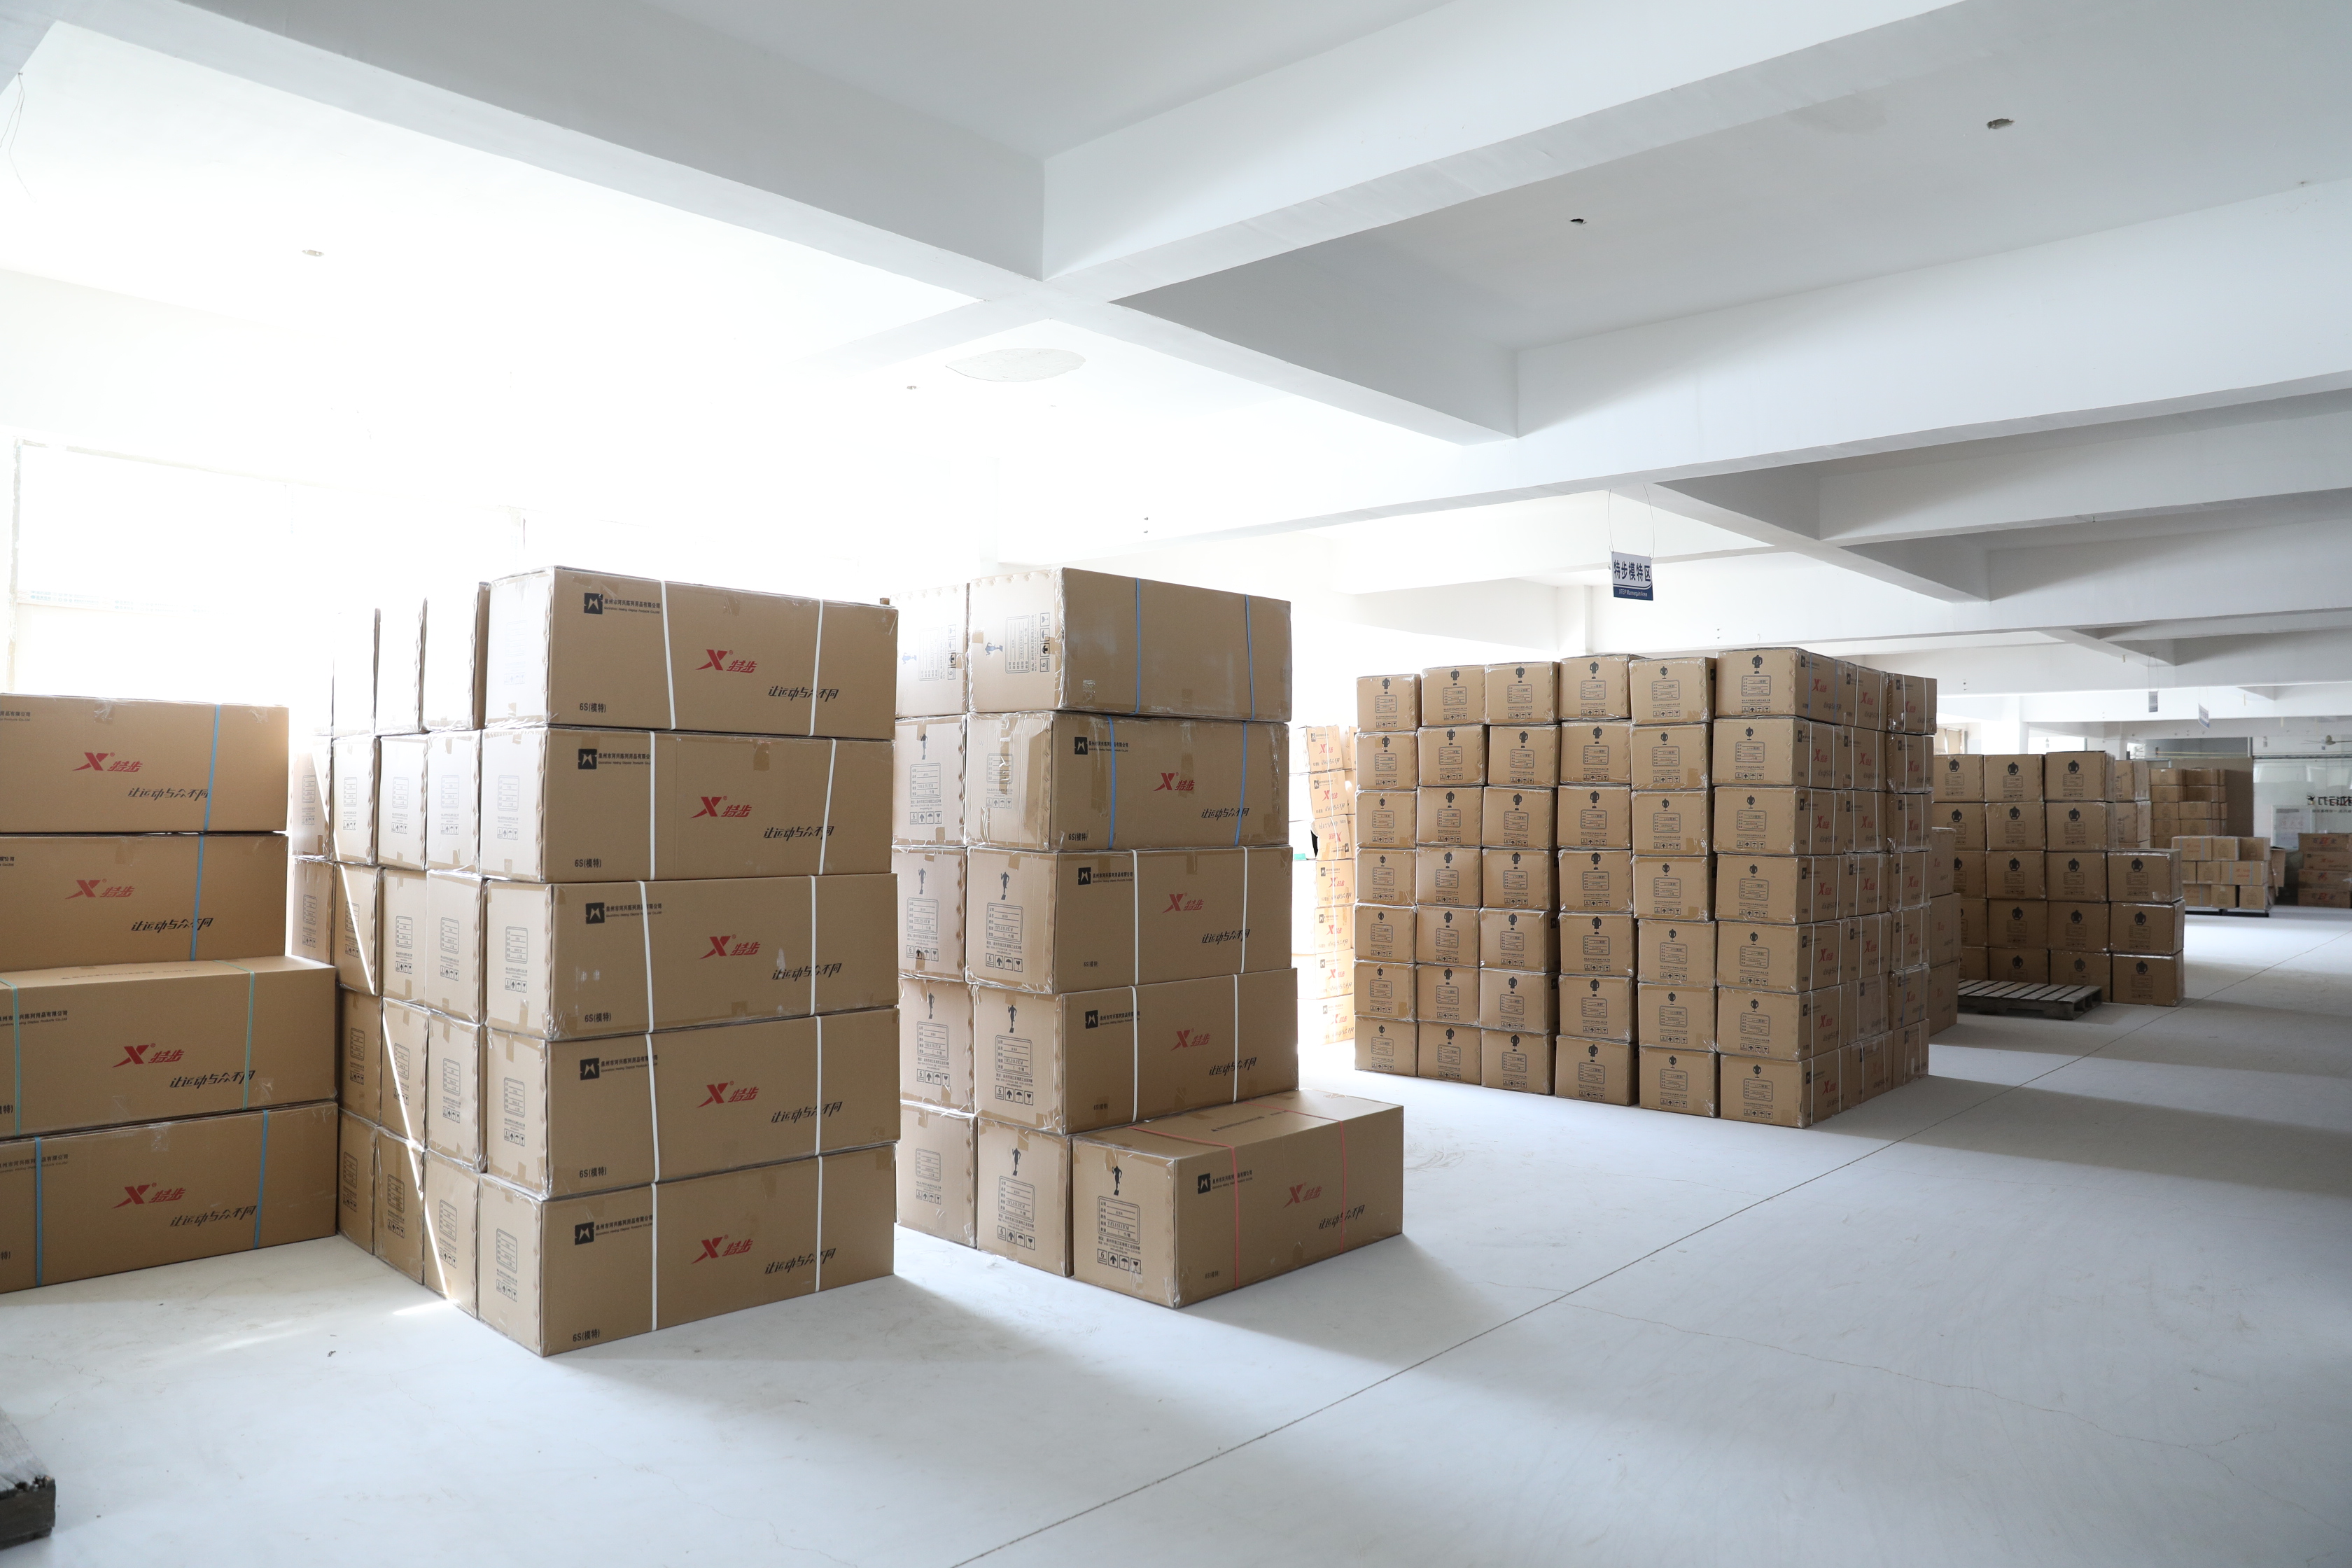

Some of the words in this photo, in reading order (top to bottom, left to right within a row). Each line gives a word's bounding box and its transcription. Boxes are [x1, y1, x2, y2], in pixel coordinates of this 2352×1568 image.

[1614, 559, 1651, 582] 特步模特区
[726, 660, 757, 673] 特步
[580, 703, 606, 713] 6S(模特)
[107, 760, 143, 772] 特步
[1175, 780, 1195, 791] 特步
[128, 788, 209, 801] 让运动与众不同
[721, 804, 752, 817] 特步
[575, 858, 601, 868] 6S(模特)
[99, 886, 134, 897] 特步
[1183, 899, 1204, 911] 特步
[730, 941, 761, 957] 特步
[0, 1010, 68, 1021] 州市兴陈列用品有限公司
[584, 1012, 612, 1023] 6S(模特)
[1190, 1033, 1210, 1046] 特步
[148, 1049, 184, 1063] 特步
[728, 1086, 759, 1102] 特步
[0, 1154, 69, 1168] 州市河兴陈列品有限公司
[580, 1166, 607, 1178] 6S(模特)
[149, 1187, 186, 1203] 特步
[1302, 1186, 1322, 1201] 特步
[171, 1205, 256, 1226] 让运动与众不同
[722, 1238, 753, 1257] 特步
[573, 1329, 600, 1342] 6S(模特)
